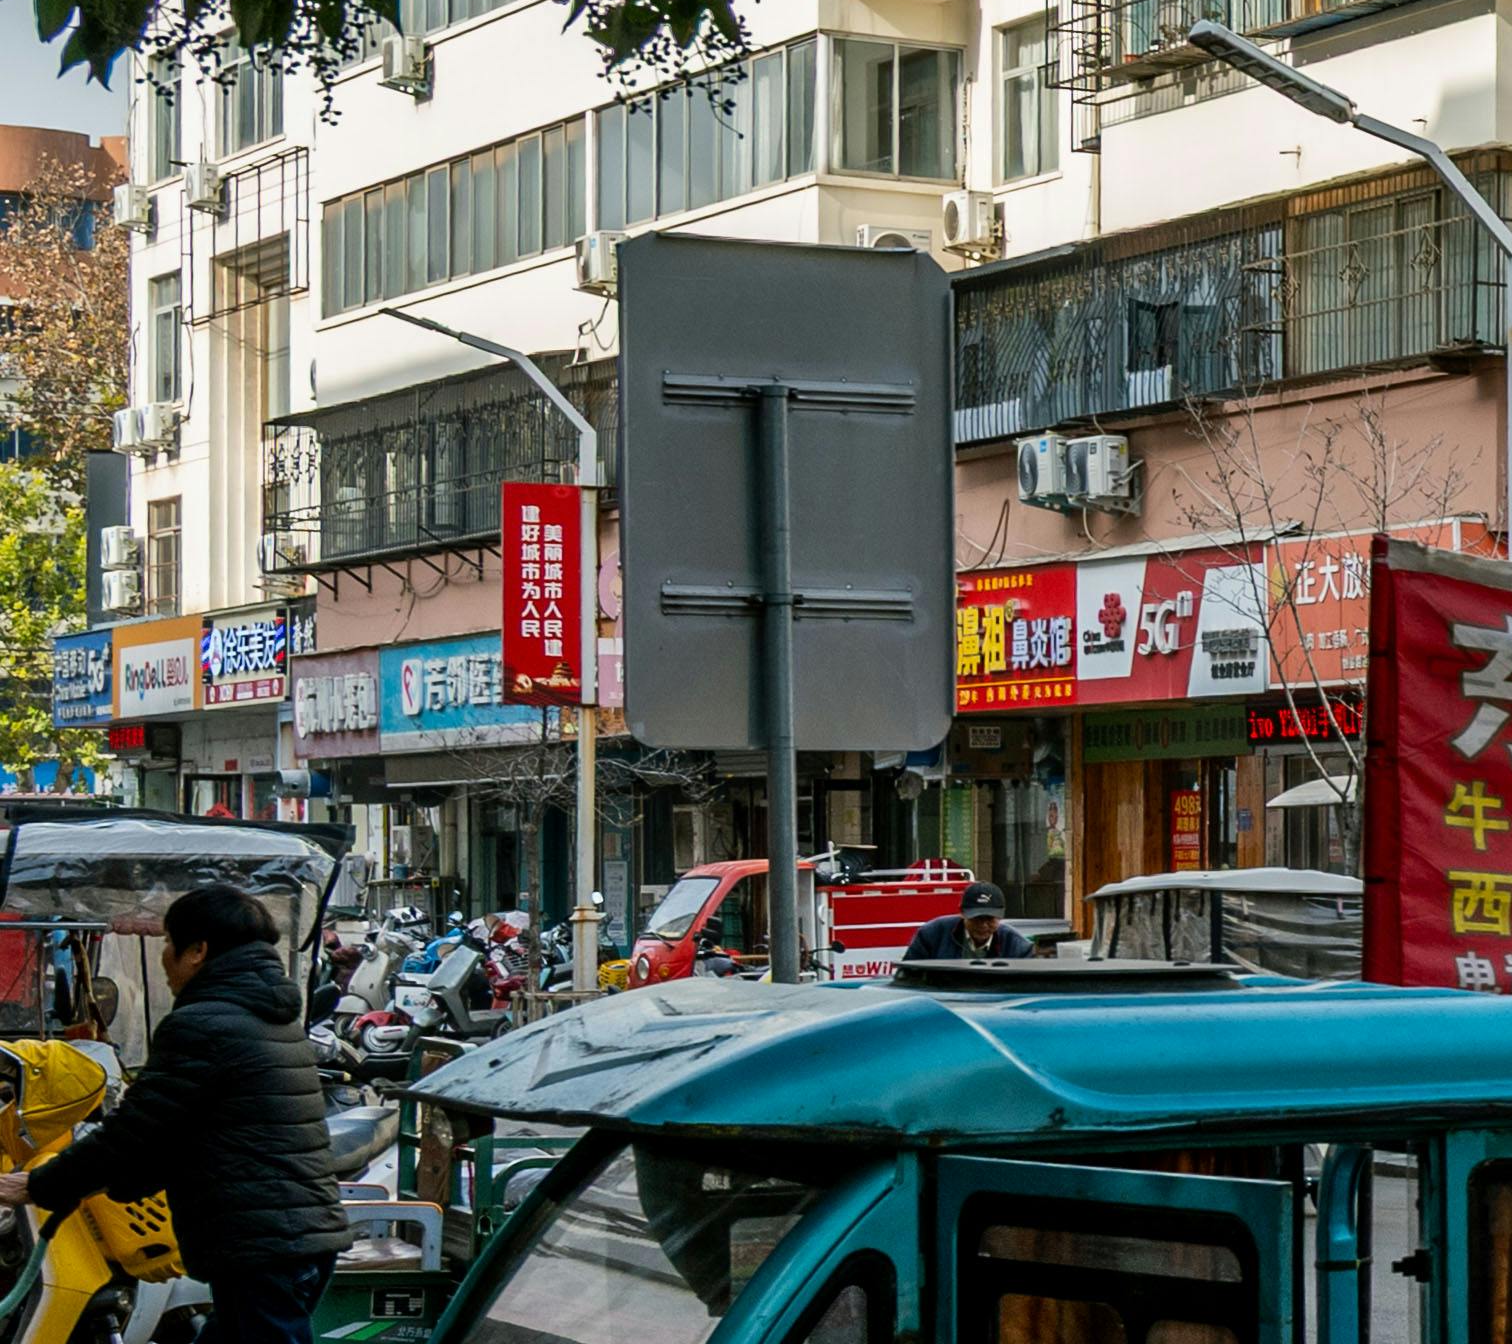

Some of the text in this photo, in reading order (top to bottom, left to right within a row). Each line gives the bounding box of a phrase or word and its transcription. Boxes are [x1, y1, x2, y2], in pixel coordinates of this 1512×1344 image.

[521, 505, 540, 638] 建好城市为人民
[544, 525, 563, 656] 美丽城市人民建
[1294, 551, 1371, 605] 正大放
